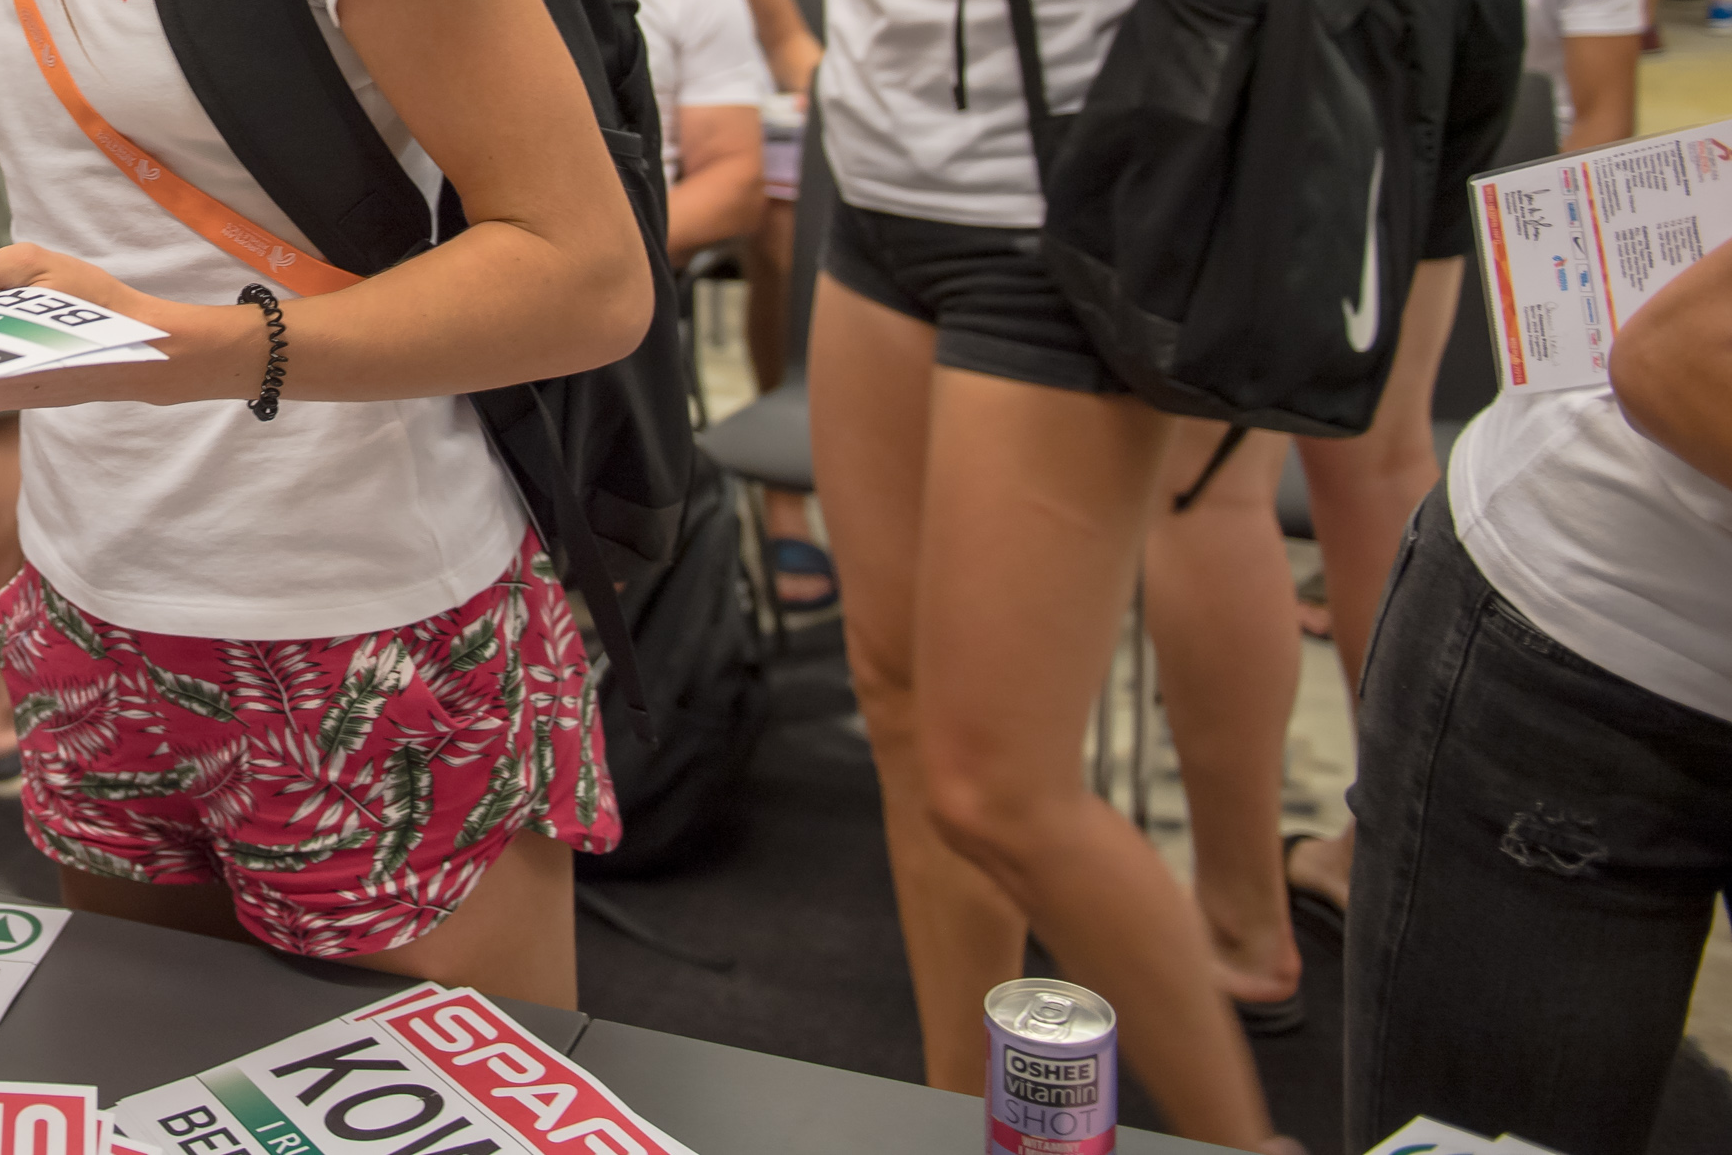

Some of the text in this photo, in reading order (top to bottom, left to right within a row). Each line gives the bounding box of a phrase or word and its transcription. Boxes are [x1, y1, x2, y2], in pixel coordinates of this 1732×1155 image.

[1011, 1056, 1090, 1081] OSHEE
[1005, 1072, 1097, 1105] vitamin
[1005, 1099, 1098, 1136] SHOT
